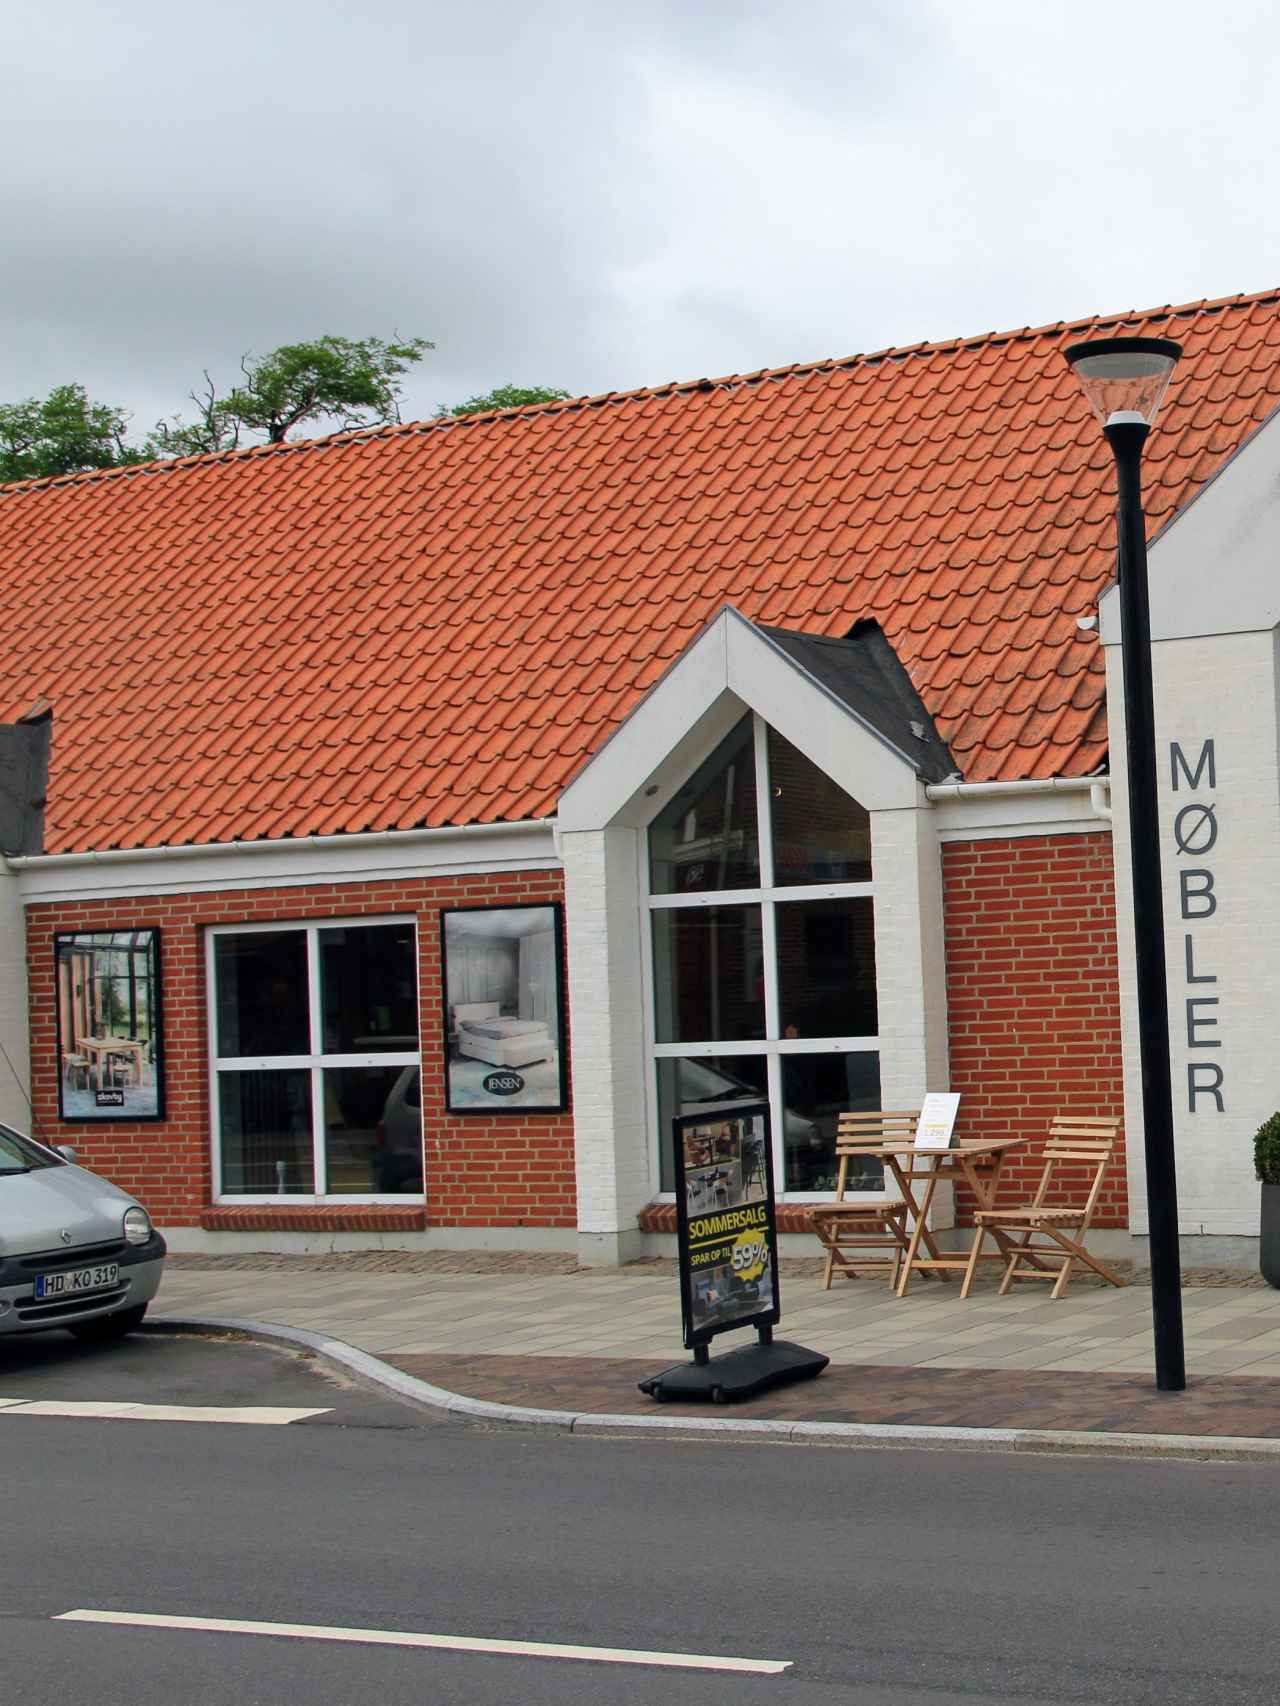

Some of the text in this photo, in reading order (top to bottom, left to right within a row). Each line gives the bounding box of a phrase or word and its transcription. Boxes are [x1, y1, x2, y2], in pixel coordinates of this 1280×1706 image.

[1169, 738, 1226, 1114] MØBLER
[488, 1078, 520, 1090] JENSEN
[689, 1206, 767, 1240] SOMMERSALG
[691, 1246, 731, 1266] SPAR OP TIL
[733, 1242, 768, 1271] 59%
[45, 1276, 64, 1294] HD
[94, 1265, 117, 1285] 319
